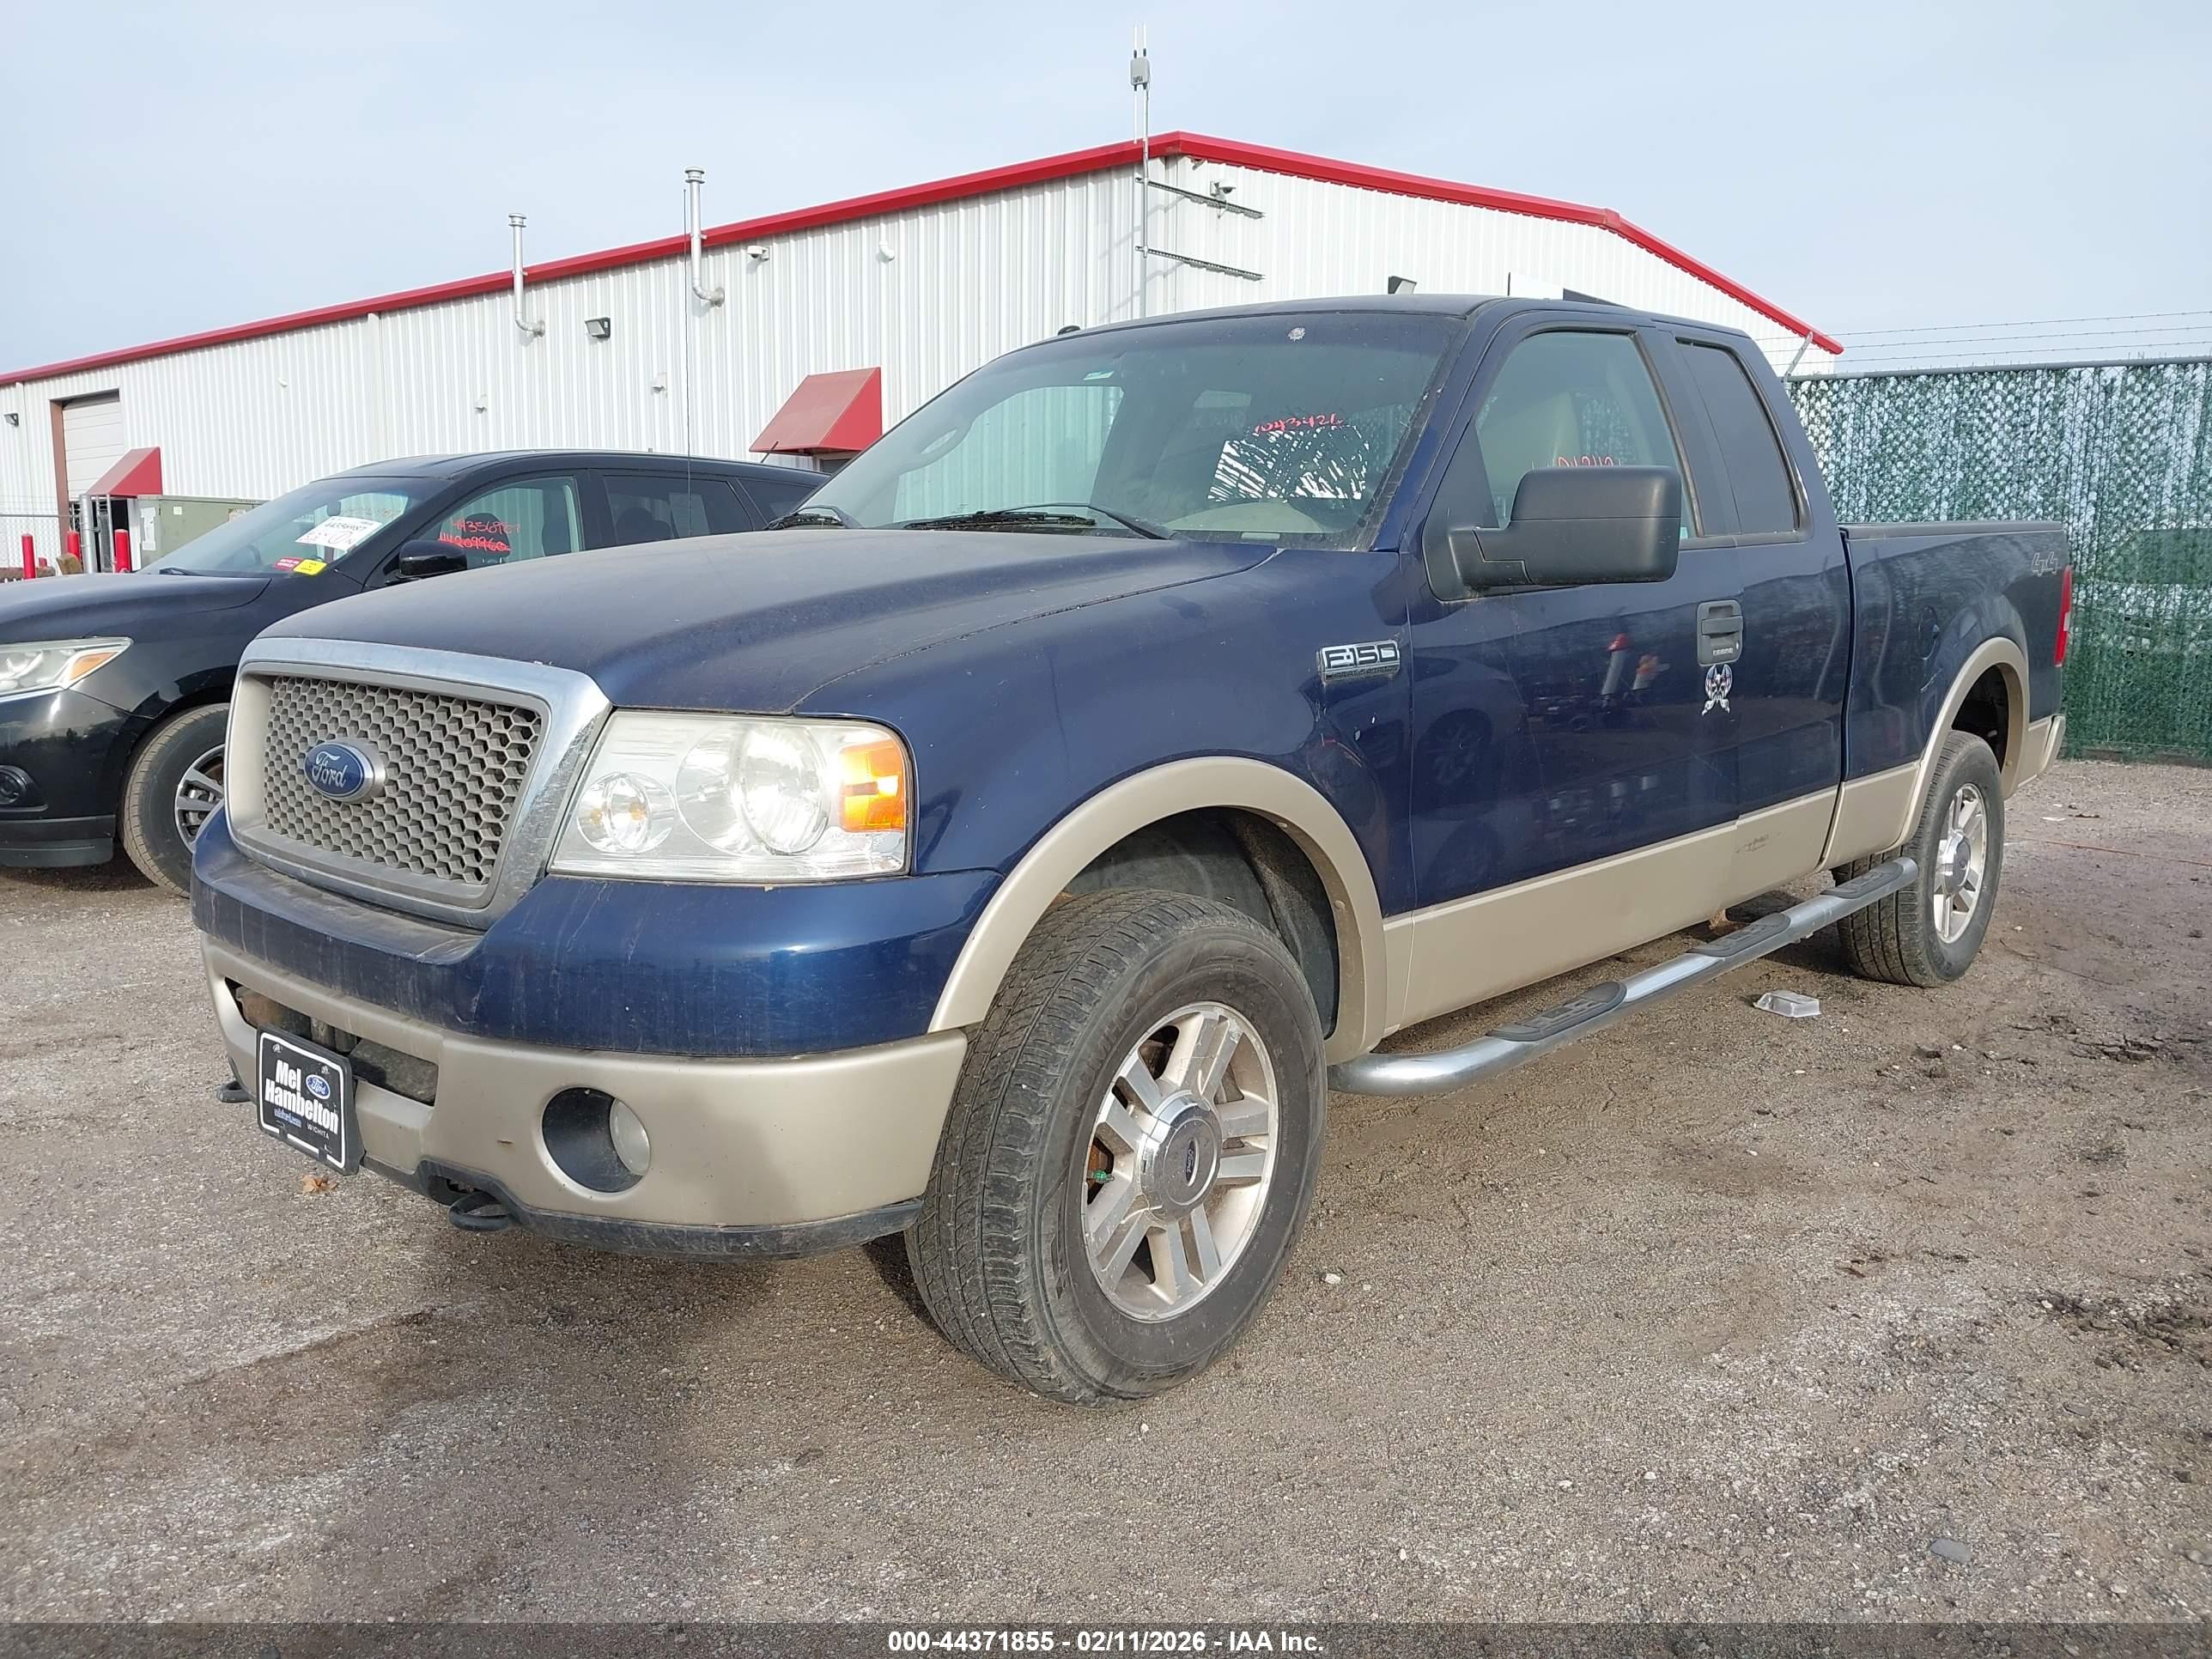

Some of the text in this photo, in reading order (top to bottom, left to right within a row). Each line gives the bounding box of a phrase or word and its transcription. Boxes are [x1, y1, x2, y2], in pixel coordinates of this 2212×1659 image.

[1325, 642, 1398, 668] F-150
[312, 750, 348, 787] Ford
[274, 1059, 301, 1092] Mel
[311, 1077, 327, 1096] Ford
[264, 1078, 339, 1134] Hambelton
[307, 1122, 330, 1140] WICHITA
